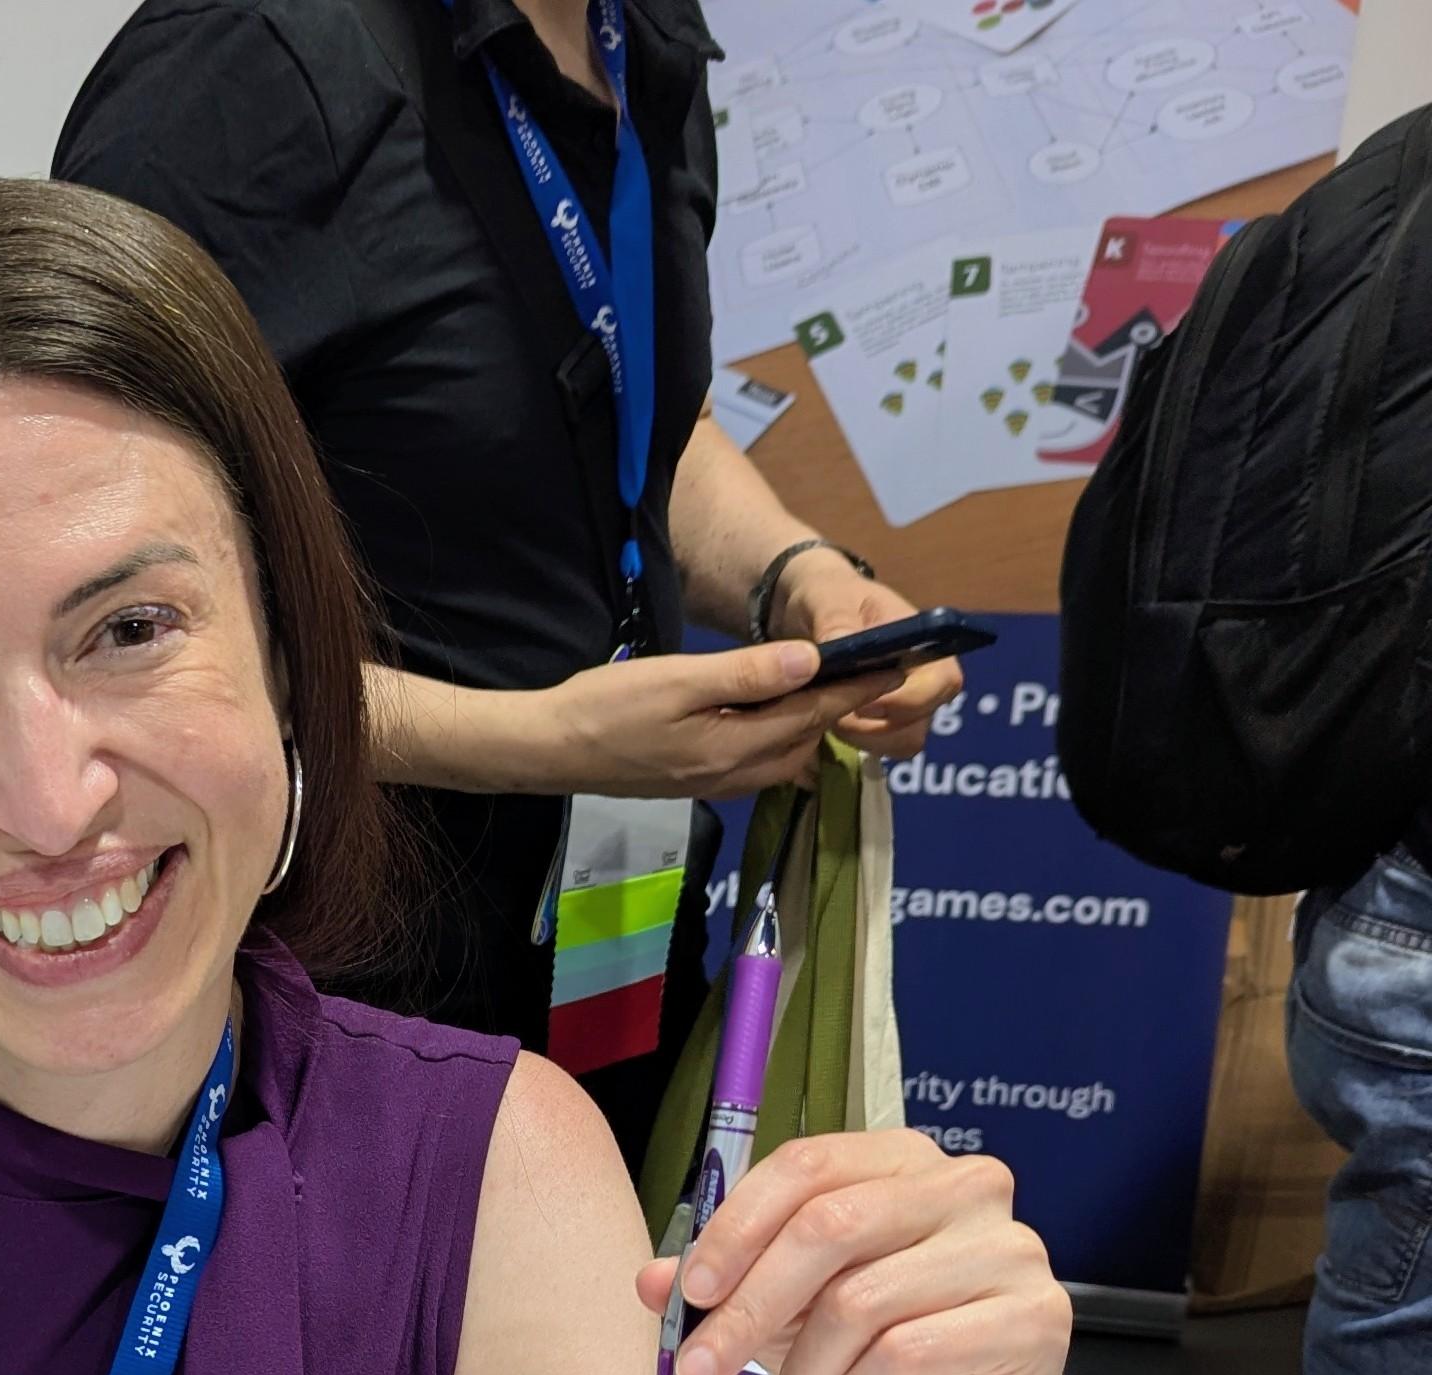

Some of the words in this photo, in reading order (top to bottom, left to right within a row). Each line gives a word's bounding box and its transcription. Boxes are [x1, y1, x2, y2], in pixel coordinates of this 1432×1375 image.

[962, 264, 982, 288] 7
[880, 753, 1072, 800] ducati
[971, 1075, 1116, 1119] through
[187, 1114, 206, 1198] SECURITY
[134, 1271, 168, 1356] SECURITY
[144, 1275, 179, 1358] PHOENIX
